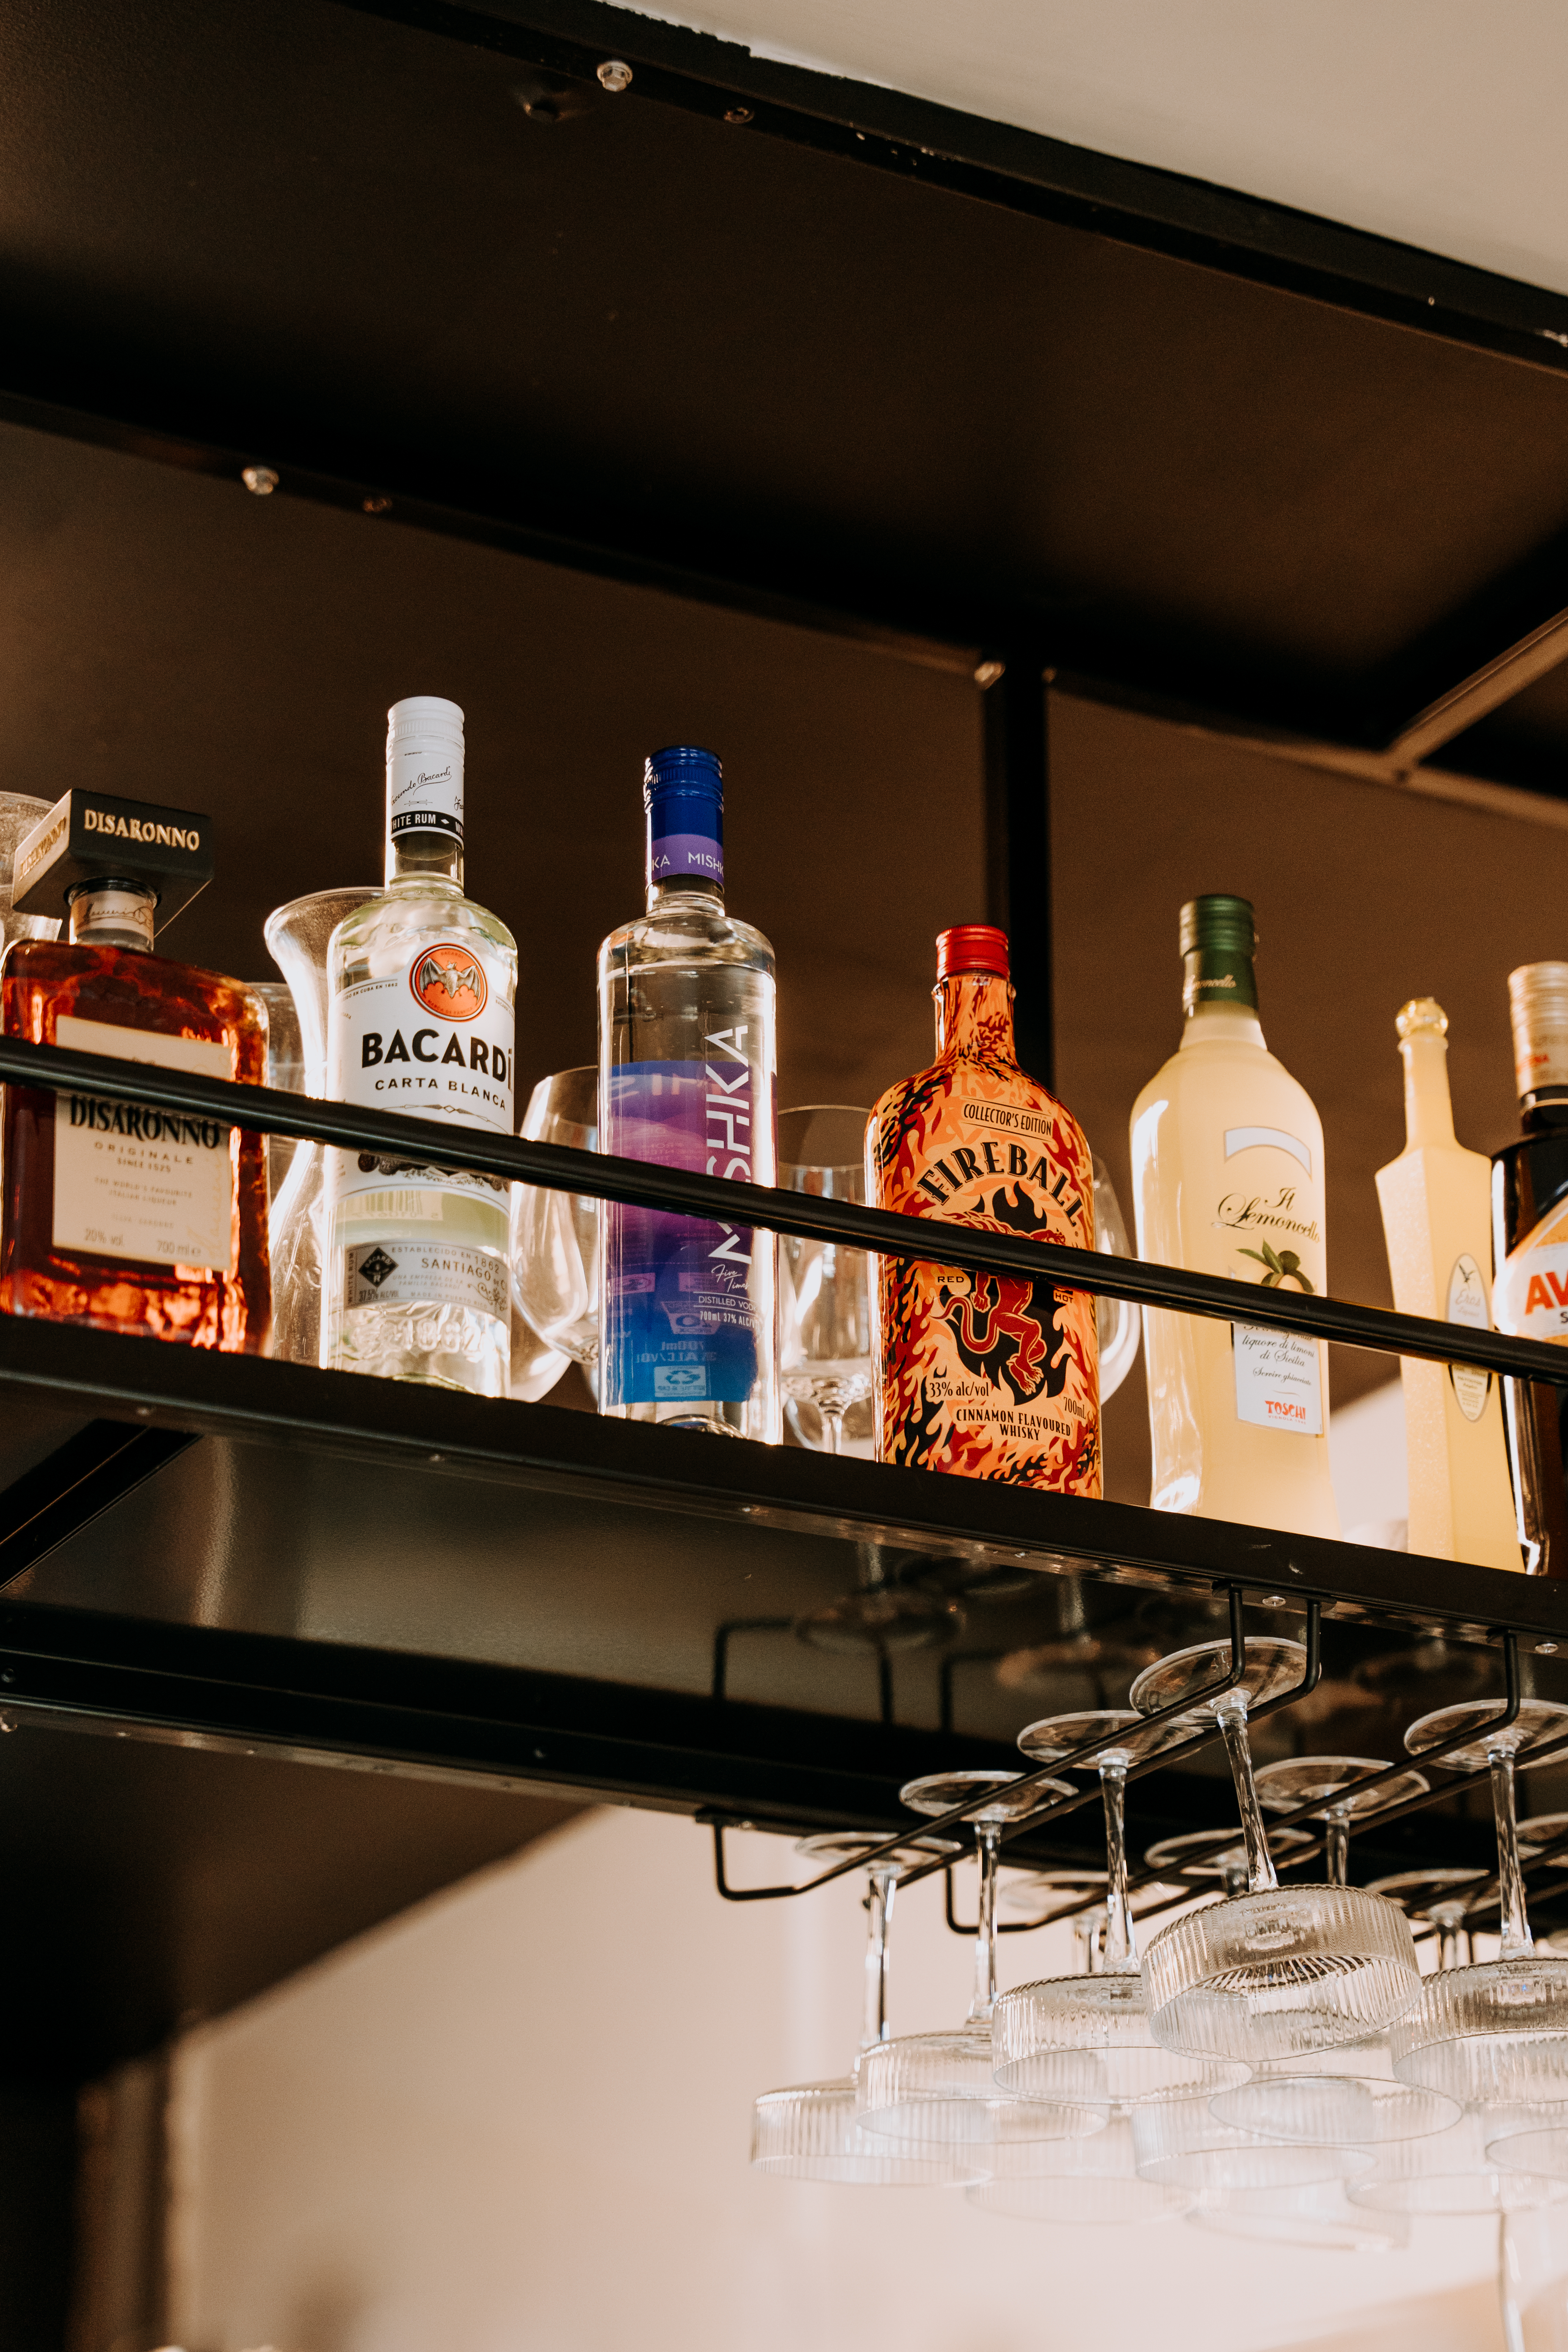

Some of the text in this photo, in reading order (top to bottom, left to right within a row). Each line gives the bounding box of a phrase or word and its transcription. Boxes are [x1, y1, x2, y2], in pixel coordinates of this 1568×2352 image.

[415, 814, 436, 824] RUM
[83, 809, 200, 851] DISARONNO
[375, 1077, 506, 1111] CARTA BLANCA
[70, 1095, 221, 1149] DISARONNO
[963, 1104, 1052, 1136] COLLECTOR'S EDITION
[94, 1141, 193, 1165] ORIGINALE
[704, 1025, 752, 1265] MSHKA
[116, 1157, 143, 1169] SINCE
[917, 1141, 1083, 1228] FIREBALL
[391, 1247, 457, 1256] ESTABLECIDO
[474, 1255, 499, 1274] 1862
[421, 1258, 491, 1281] SANTIAGO
[711, 1264, 738, 1283] Five
[723, 1274, 750, 1293] Times
[698, 1296, 758, 1313] DISTILLED VODK
[1055, 1292, 1074, 1304] HOT
[699, 1311, 721, 1322] 700mL
[723, 1312, 737, 1324] 37%
[1242, 1334, 1315, 1358] liquore di limoni
[1260, 1349, 1306, 1367] di Sicilia
[1253, 1366, 1282, 1378] Servire
[929, 1381, 989, 1398] 33% alc/vol
[1063, 1396, 1086, 1420] 700mL
[1264, 1400, 1306, 1420] TOSCHI
[956, 1409, 1071, 1437] CINNAMON FLAVOURED
[999, 1423, 1040, 1441] WHISKY
